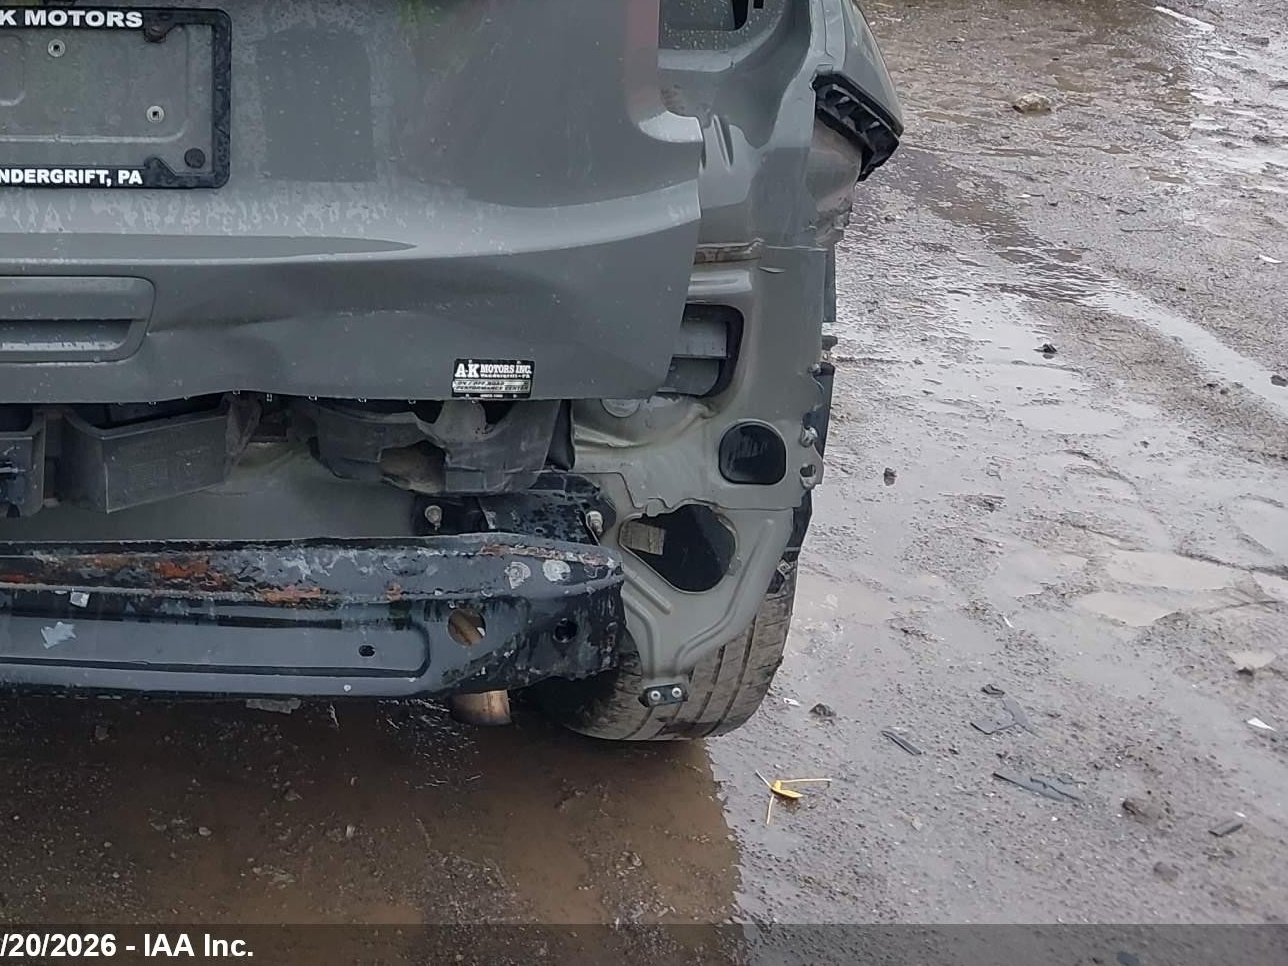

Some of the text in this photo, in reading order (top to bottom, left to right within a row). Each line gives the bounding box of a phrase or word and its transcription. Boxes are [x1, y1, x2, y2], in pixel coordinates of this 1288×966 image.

[24, 9, 144, 28] MOTORS
[118, 169, 143, 185] PA
[480, 364, 515, 374] MOTORS
